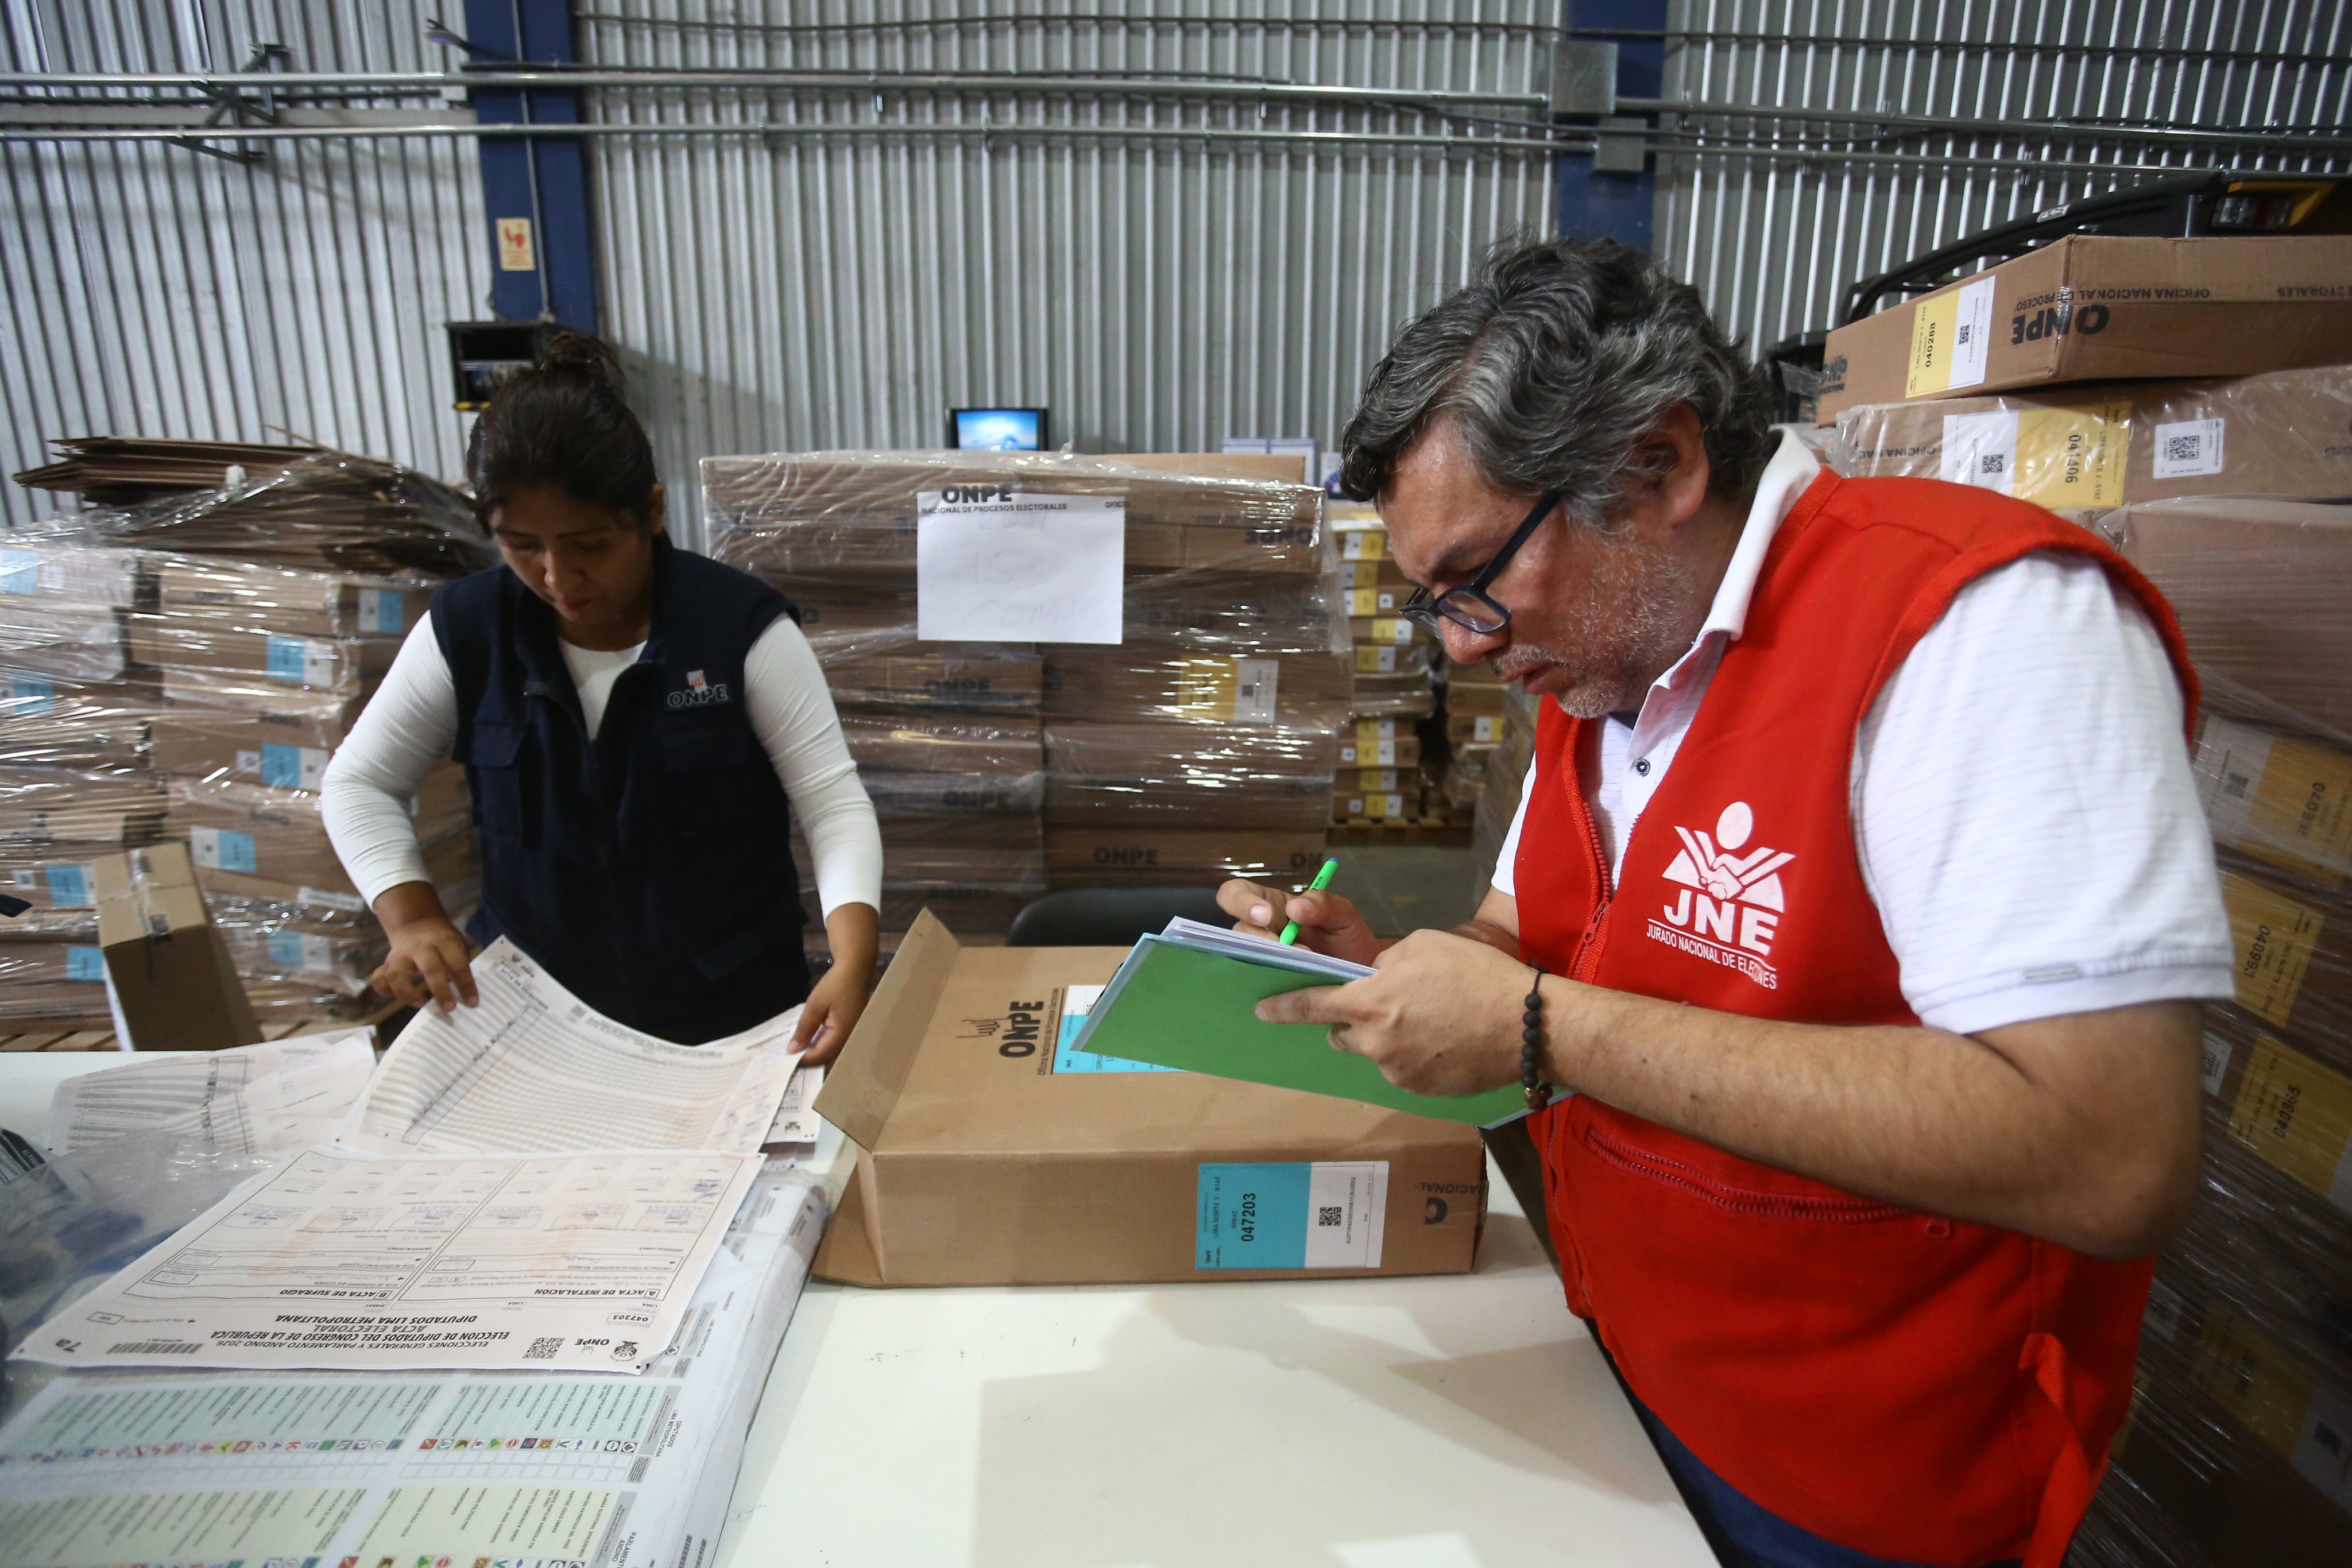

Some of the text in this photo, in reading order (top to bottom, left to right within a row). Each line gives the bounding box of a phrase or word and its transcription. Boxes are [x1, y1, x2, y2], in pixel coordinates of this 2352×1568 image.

[2080, 290, 2151, 300] NACIONAL
[2155, 289, 2210, 298] OFICINA
[2011, 304, 2110, 344] ONPE
[1925, 322, 1936, 367] 040288
[1887, 446, 1936, 457] OFICINA
[941, 485, 1012, 504] ONPE
[973, 505, 1014, 513] PROCESOS
[1016, 503, 1067, 511] ELECTORALES
[667, 683, 728, 707] ONPE
[1093, 847, 1158, 866] ONPE
[1663, 889, 1778, 957] JNE
[1646, 924, 1736, 969] JURADO NACIONAL DE
[2243, 926, 2270, 978] 040993
[1049, 988, 1059, 1009] Electorales
[1045, 1010, 1055, 1028] Procesos
[998, 1001, 1044, 1058] ONPE
[1042, 1036, 1051, 1056] Nacional
[1037, 1058, 1048, 1076] Oficina
[1420, 1182, 1487, 1194] ACIONAL
[1240, 1193, 1256, 1242] 047203
[276, 1315, 376, 1324] METROPOLITANA
[409, 1315, 478, 1324] DIPUTADOS
[210, 1331, 269, 1341] REPÚBLICA
[271, 1332, 285, 1340] LA
[303, 1333, 359, 1341] CONGRESO
[363, 1333, 381, 1341] DEL
[382, 1333, 442, 1341] DIPUTADOS
[461, 1331, 510, 1342] ELECCIÓN
[574, 1338, 610, 1346] ONPE
[55, 1338, 82, 1353] 7a
[670, 1410, 679, 1420] LIMA
[655, 1421, 674, 1457] METROPOLITANA
[667, 1420, 682, 1447] DIPUTADOS
[475, 1488, 488, 1503] PARTIDO
[511, 1488, 523, 1504] PARTIDO
[529, 1489, 540, 1504] PARTIDO
[550, 1489, 560, 1503] FRENTE
[565, 1490, 575, 1506] PARTIDO
[582, 1492, 593, 1507] PARTIDO
[501, 1512, 510, 1523] BUEN
[541, 1504, 554, 1521] POPULAR
[551, 1520, 561, 1533] OBRAS
[578, 1493, 610, 1557] ALIANZA ELECTORAL VENCEREMOS
[490, 1523, 504, 1543] GOBIERNO
[510, 1528, 520, 1541] VERDE
[612, 1539, 625, 1562] ANDINO
